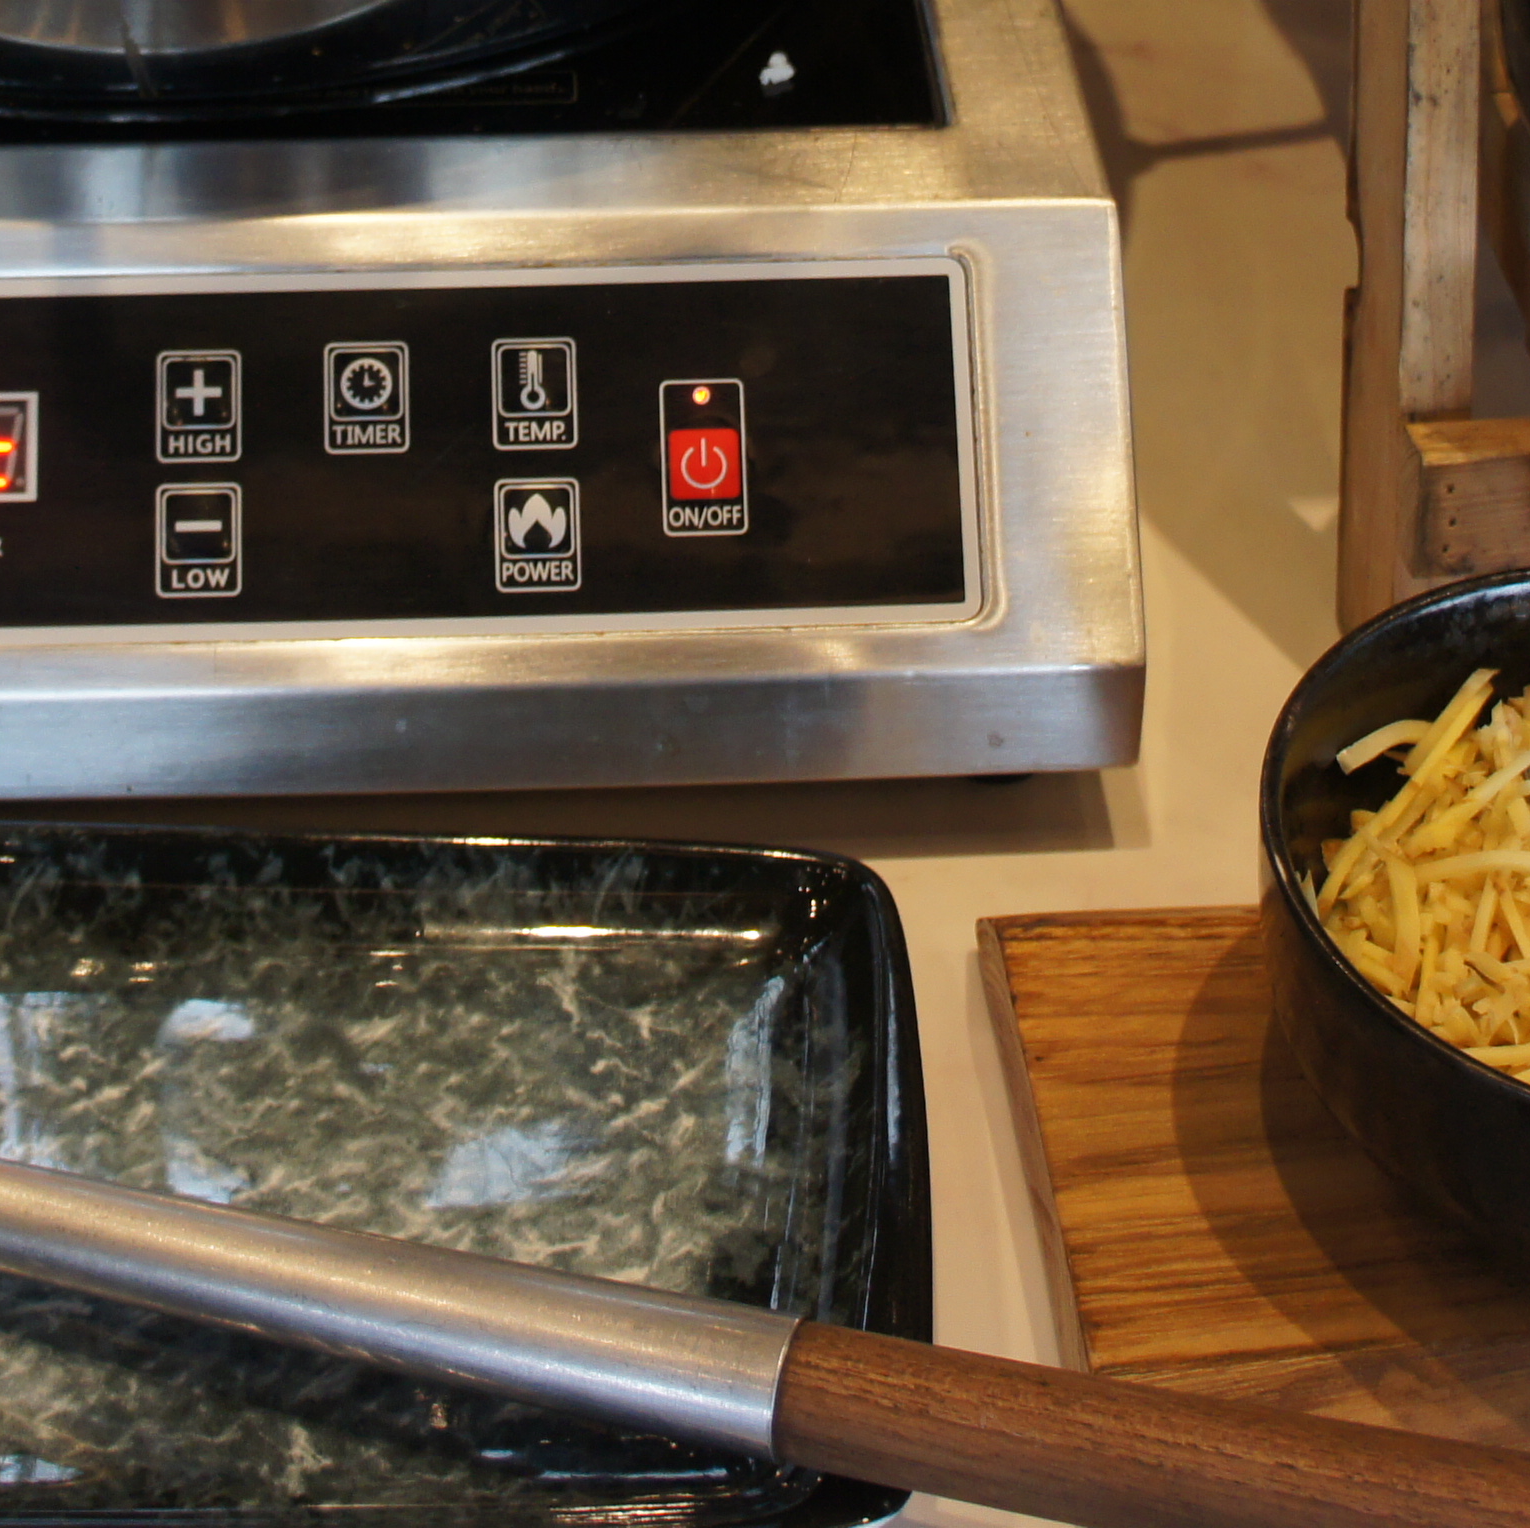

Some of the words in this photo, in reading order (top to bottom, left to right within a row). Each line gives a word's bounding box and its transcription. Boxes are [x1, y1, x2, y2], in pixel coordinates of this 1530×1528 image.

[332, 424, 402, 446] TIMER
[505, 420, 566, 443] TEMP.
[169, 434, 231, 455] HIGH
[669, 505, 743, 529] ON/OFF
[171, 568, 230, 590] LOW
[502, 561, 574, 583] POWER
